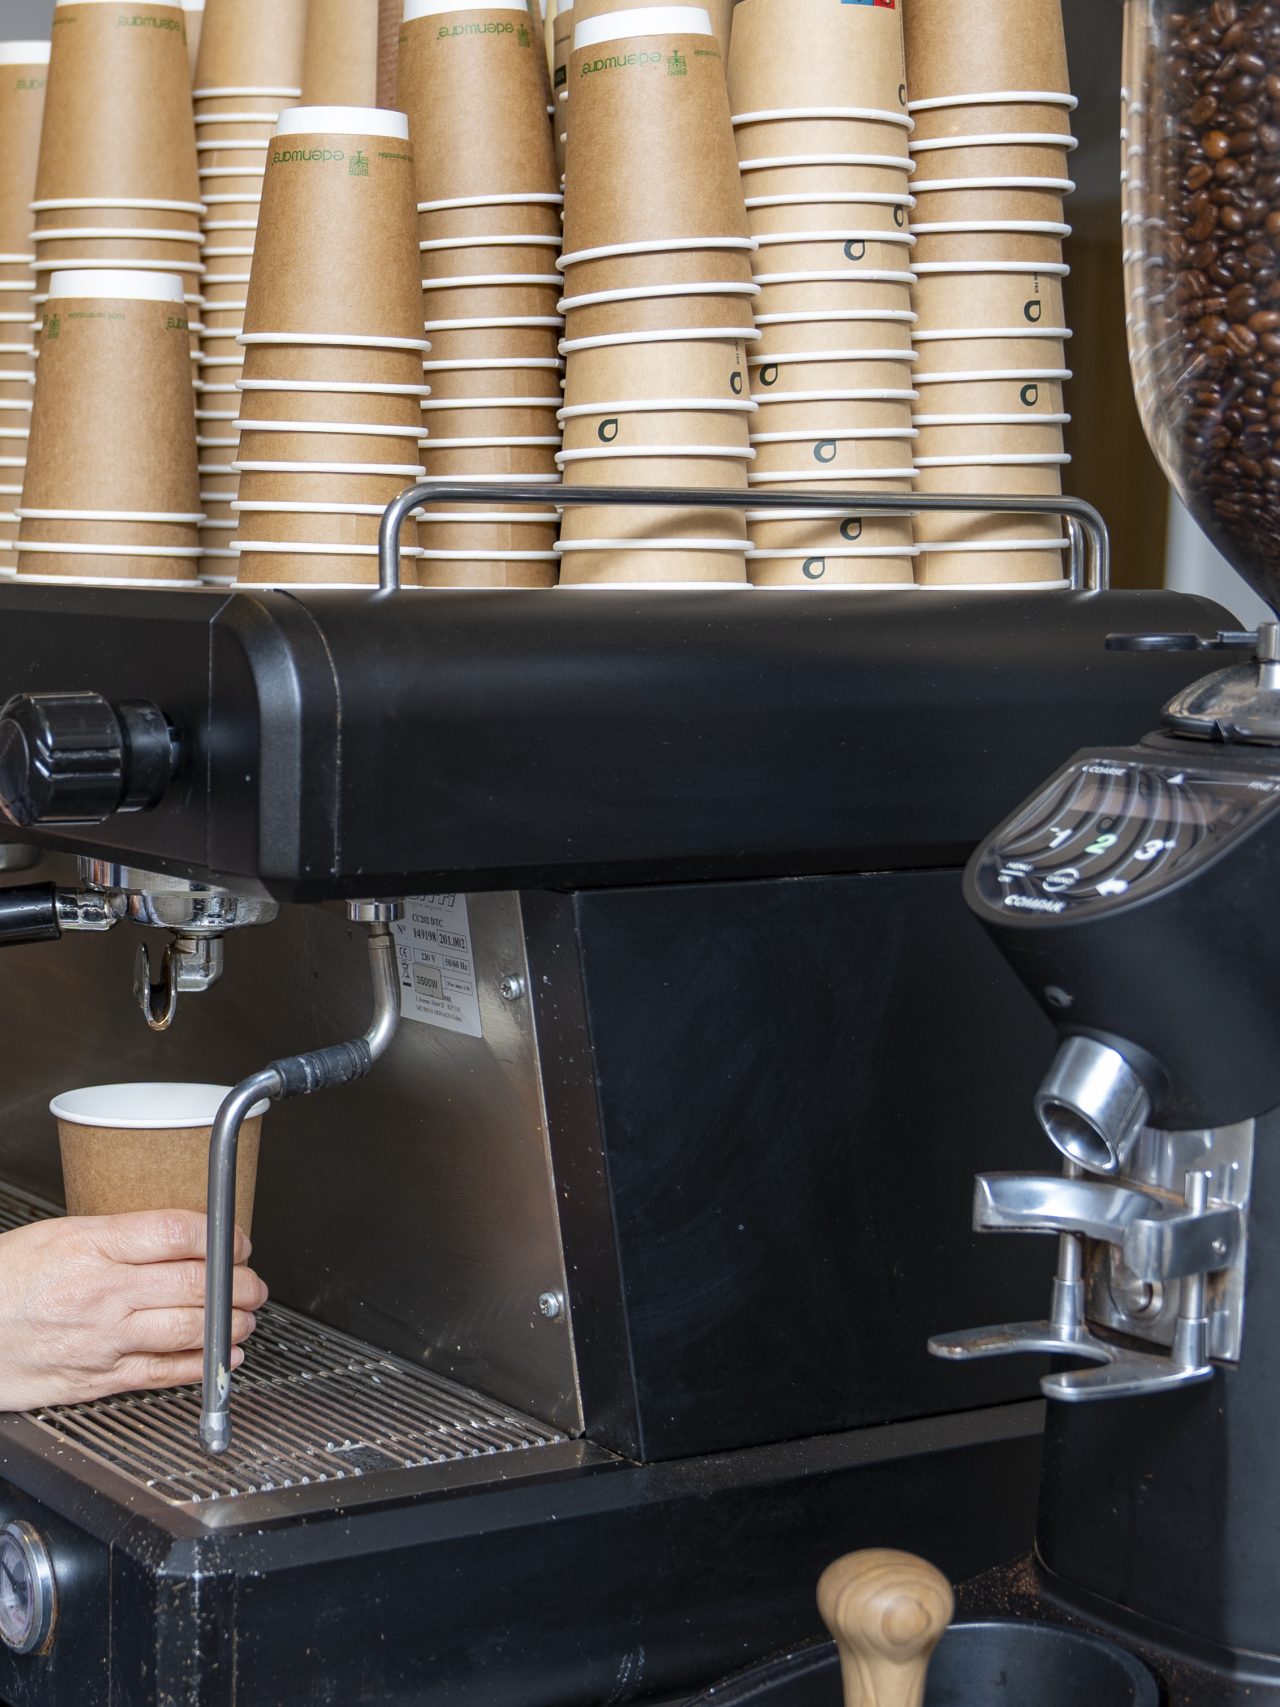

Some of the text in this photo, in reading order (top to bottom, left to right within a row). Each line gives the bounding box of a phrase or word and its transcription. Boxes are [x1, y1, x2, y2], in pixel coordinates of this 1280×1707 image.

[437, 22, 514, 39] edenware
[581, 50, 661, 77] edenware
[273, 149, 344, 164] edenware
[1084, 833, 1118, 855] 2
